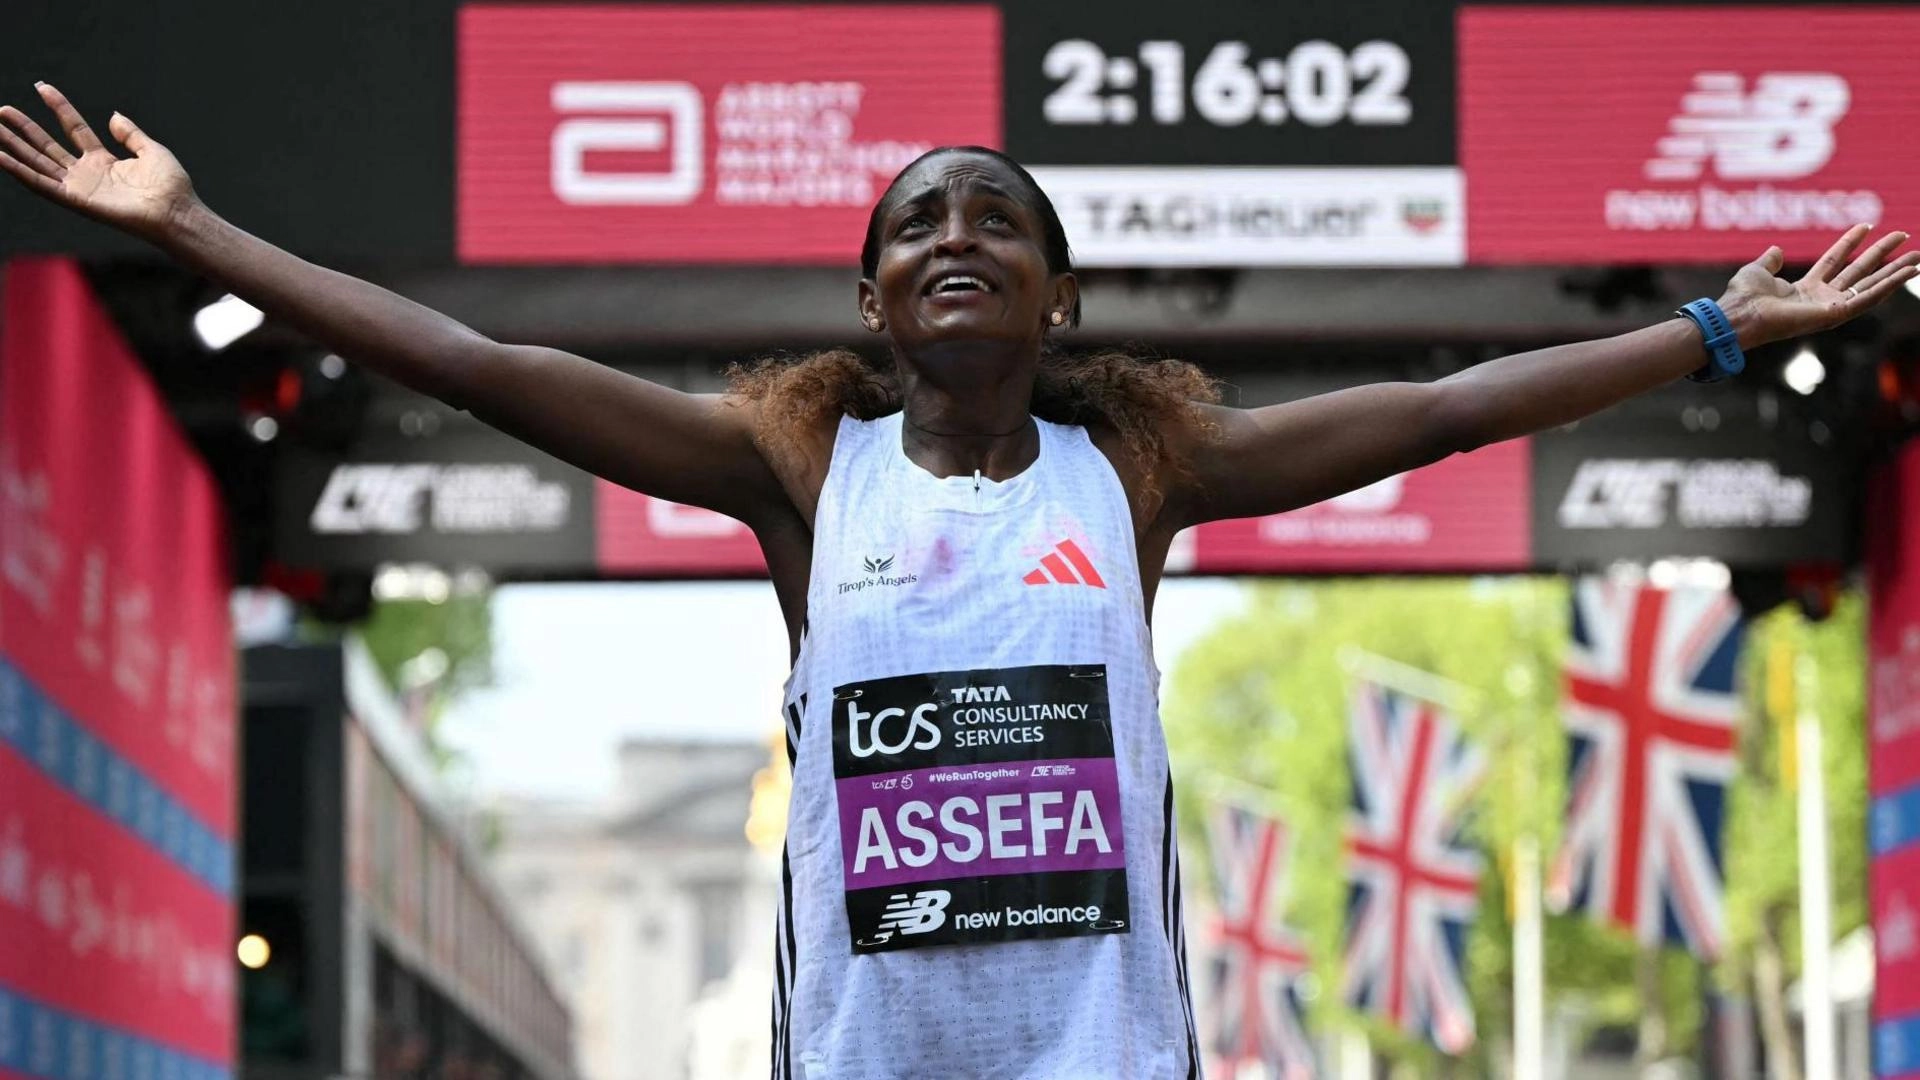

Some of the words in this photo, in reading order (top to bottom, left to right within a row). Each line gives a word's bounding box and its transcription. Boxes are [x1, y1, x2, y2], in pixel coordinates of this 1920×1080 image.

[1043, 39, 1413, 127] 2:16:02
[1604, 190, 1698, 230] new
[1700, 184, 1883, 231] balance
[838, 577, 874, 594] Tirop's
[876, 573, 917, 587] Angels
[951, 685, 1012, 704] TATA
[953, 703, 1089, 726] CONSULTANCY
[848, 700, 942, 758] tcs
[954, 726, 1045, 748] SERVICES
[928, 768, 1020, 784] #WeRunTogether
[853, 790, 1112, 874] ASSEFA
[955, 911, 1001, 930] new
[1006, 904, 1101, 927] balance
